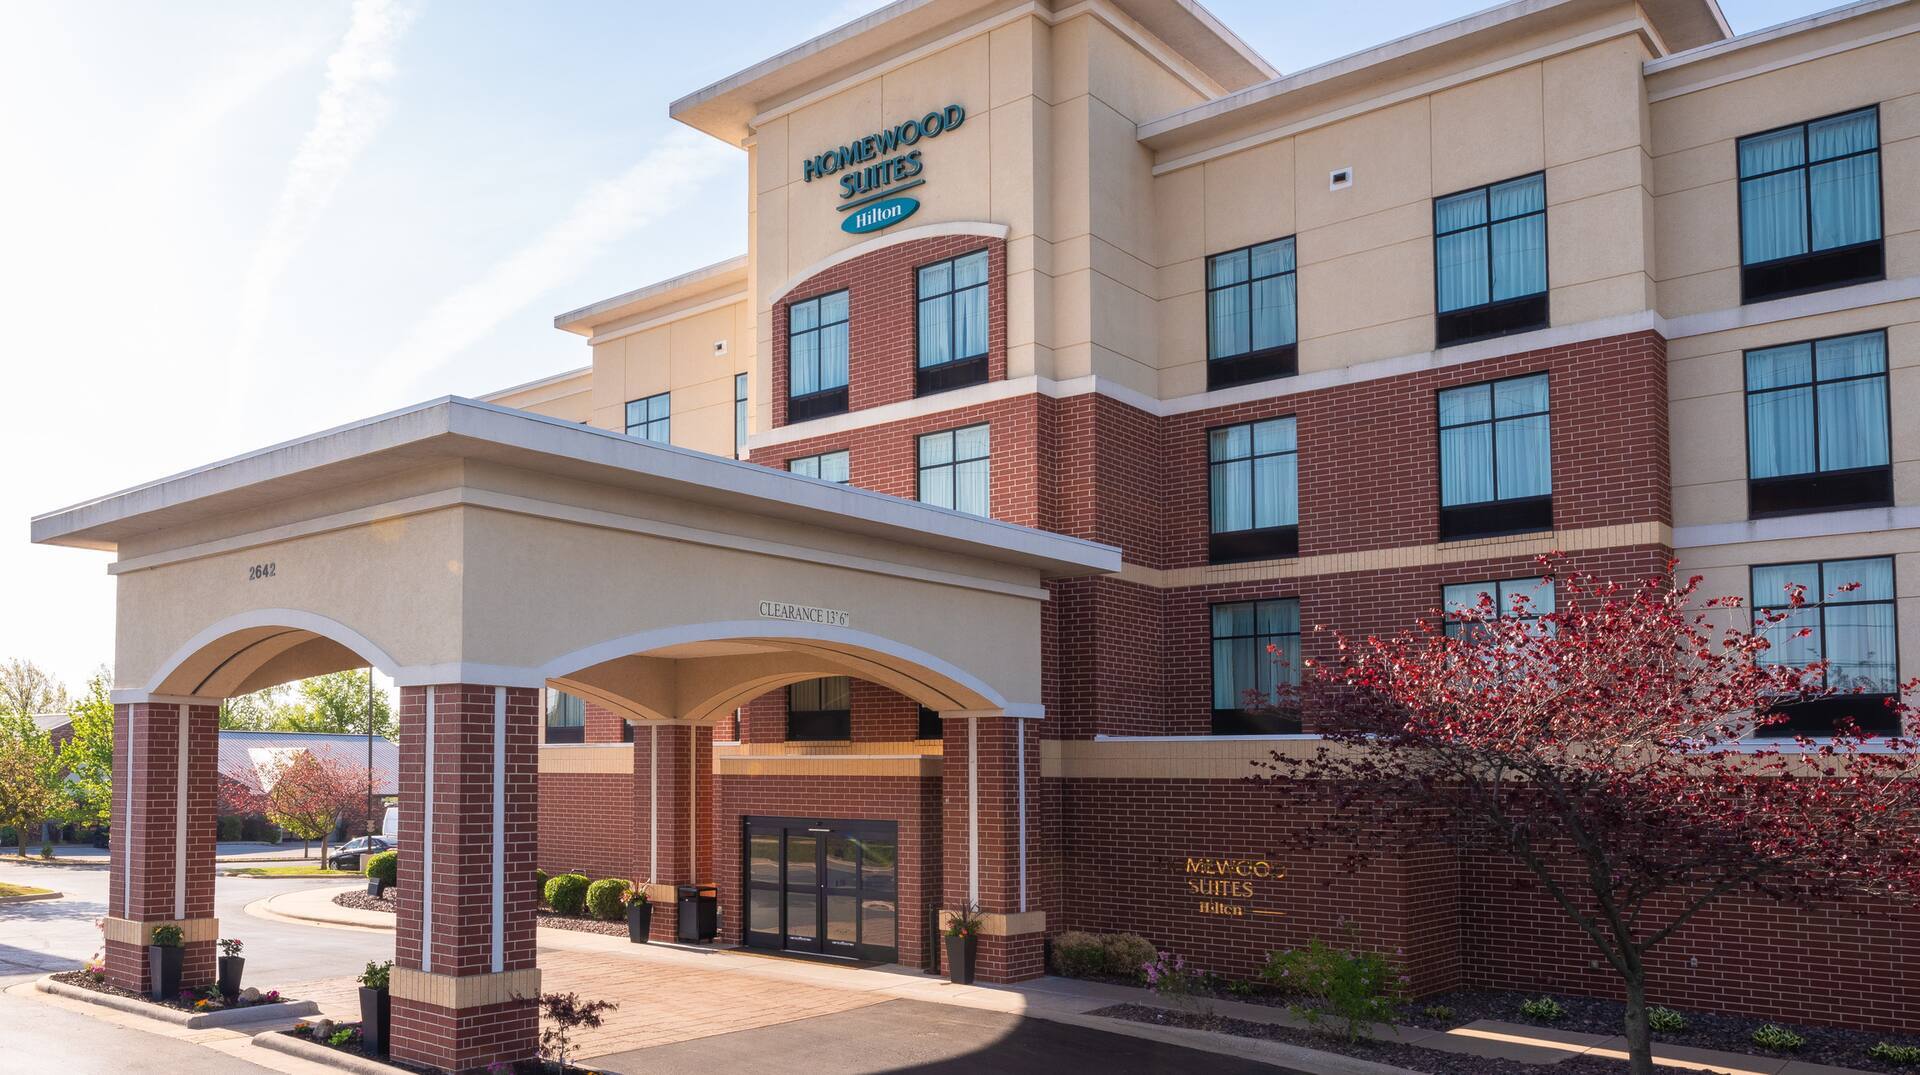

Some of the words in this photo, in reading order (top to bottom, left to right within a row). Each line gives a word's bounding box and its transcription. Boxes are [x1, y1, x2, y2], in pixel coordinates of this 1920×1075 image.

[803, 104, 966, 183] HOMEWOOD
[839, 150, 923, 199] SUITES
[856, 204, 902, 229] Hilton
[249, 562, 276, 581] 2642
[759, 601, 823, 623] CLEARANCE
[1187, 879, 1254, 898] SUITES
